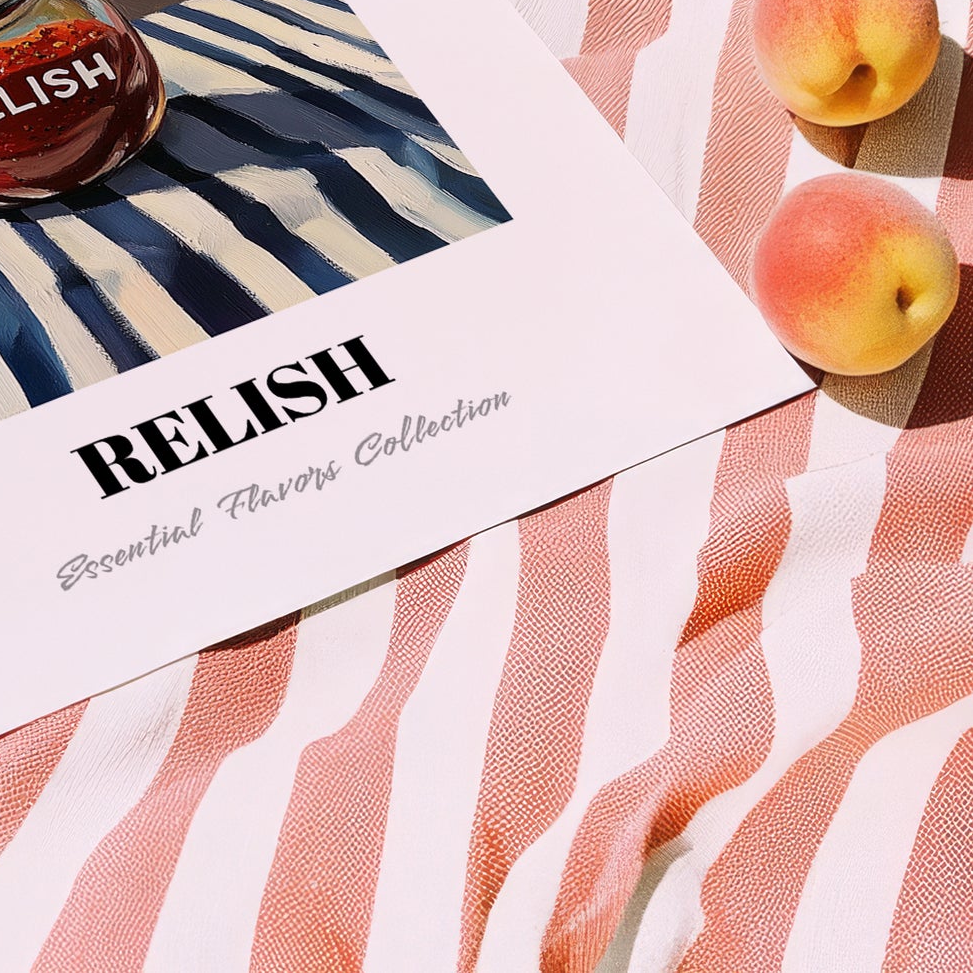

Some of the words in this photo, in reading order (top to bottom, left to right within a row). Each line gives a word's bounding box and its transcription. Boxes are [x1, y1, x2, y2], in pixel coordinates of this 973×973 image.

[56, 507, 204, 591] Essential
[217, 460, 342, 519] Flavors
[354, 389, 512, 466] Collection
[70, 335, 395, 500] RELISH
